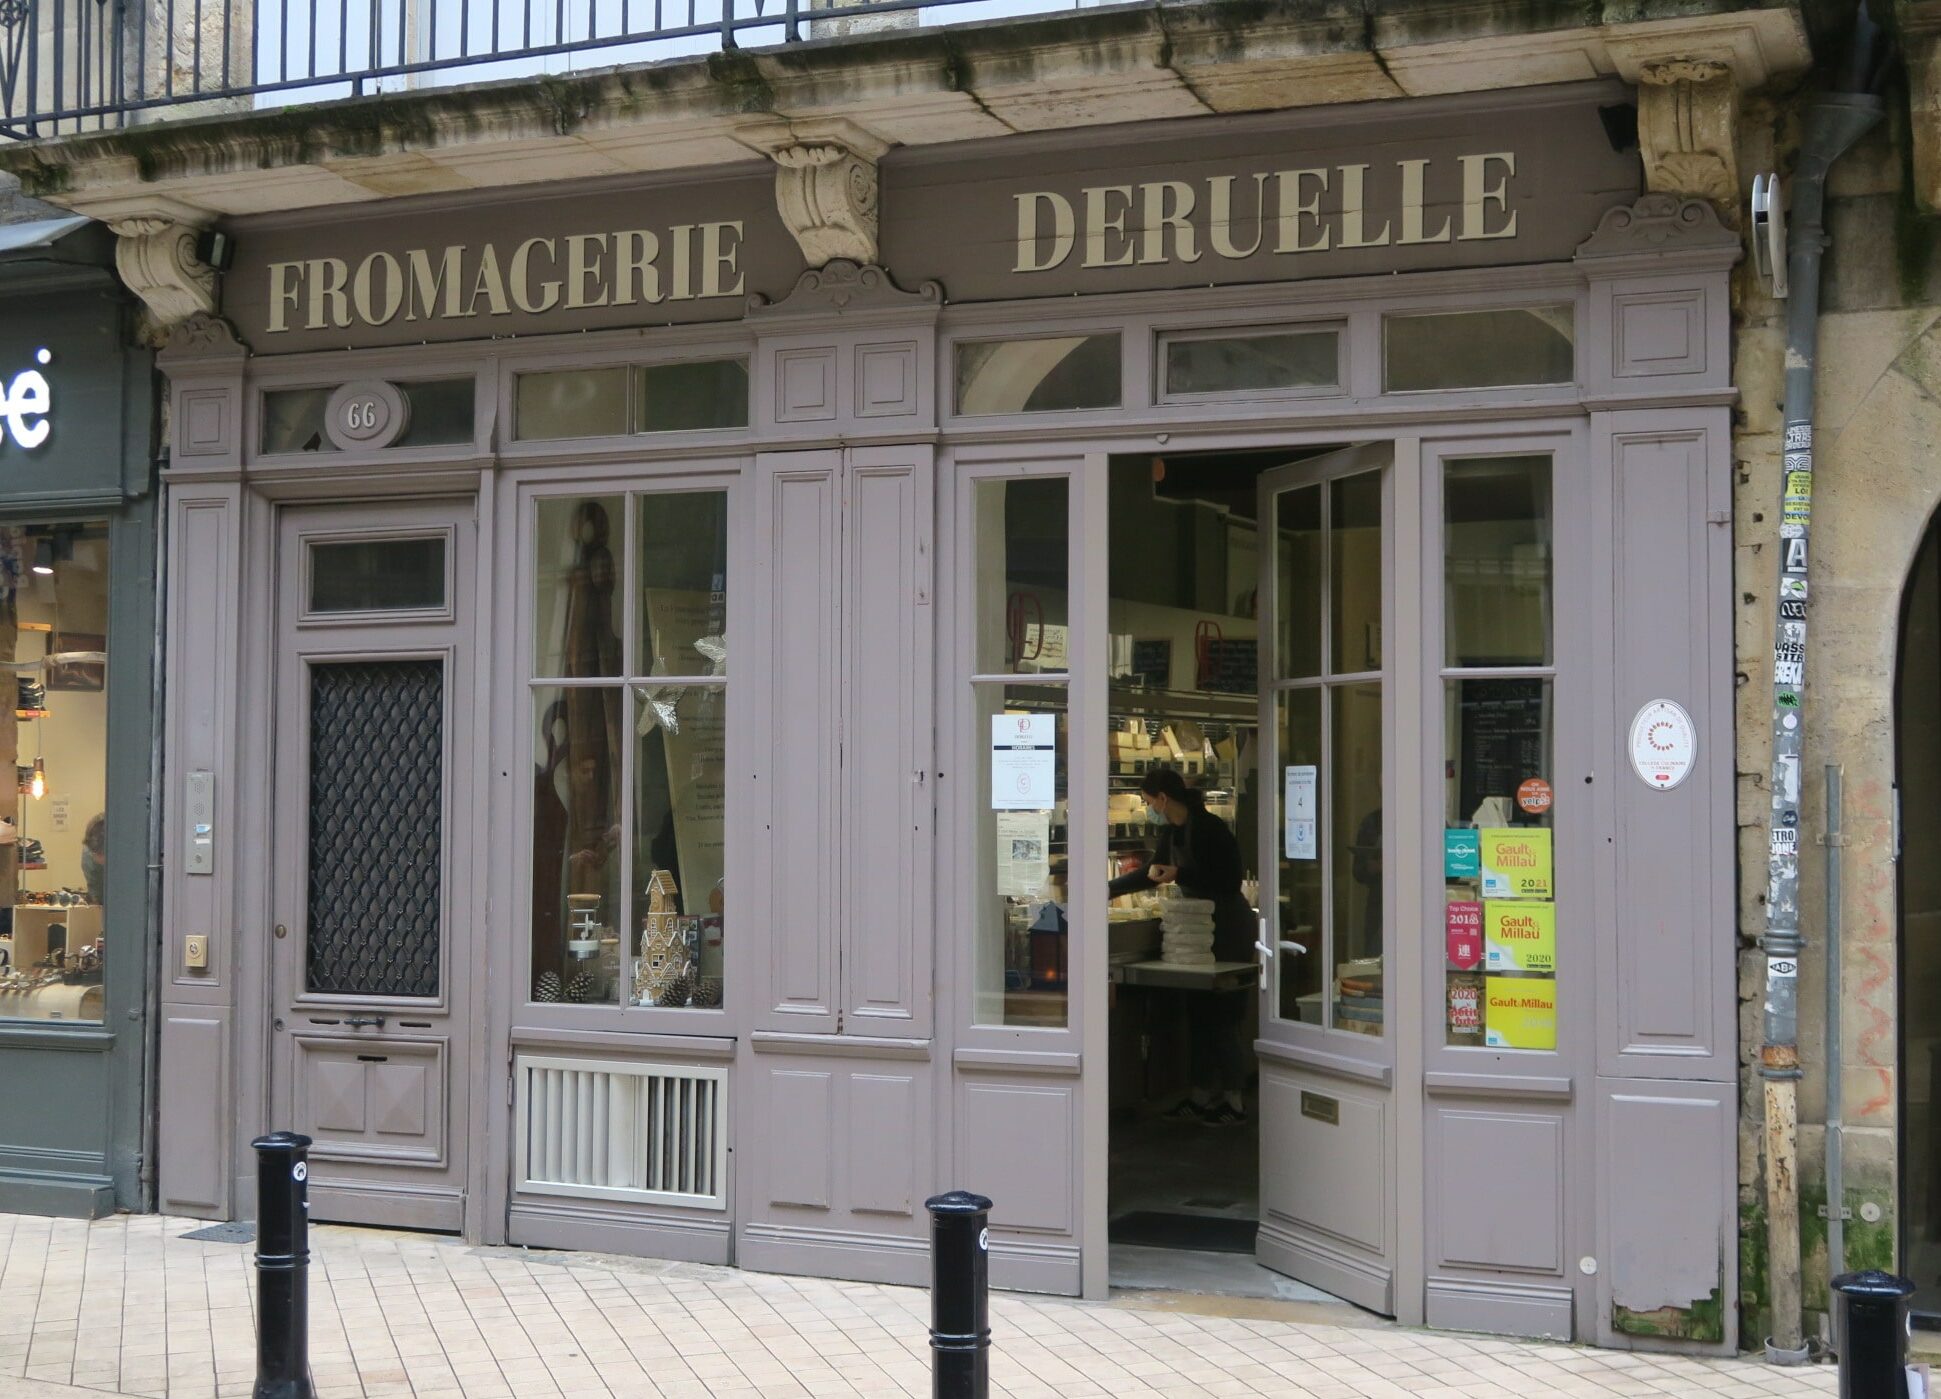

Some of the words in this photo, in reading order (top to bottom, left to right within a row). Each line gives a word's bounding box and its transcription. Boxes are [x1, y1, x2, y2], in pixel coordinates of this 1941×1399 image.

[267, 220, 746, 333] FROMAGERIE
[1012, 152, 1518, 273] DERUELLE
[347, 402, 376, 429] 66
[1786, 538, 1807, 567] A
[1497, 855, 1536, 867] Millau
[1521, 879, 1547, 887] 2021
[1501, 928, 1540, 939] Millau
[1526, 954, 1551, 963] 2020
[1451, 989, 1477, 1000] 2020
